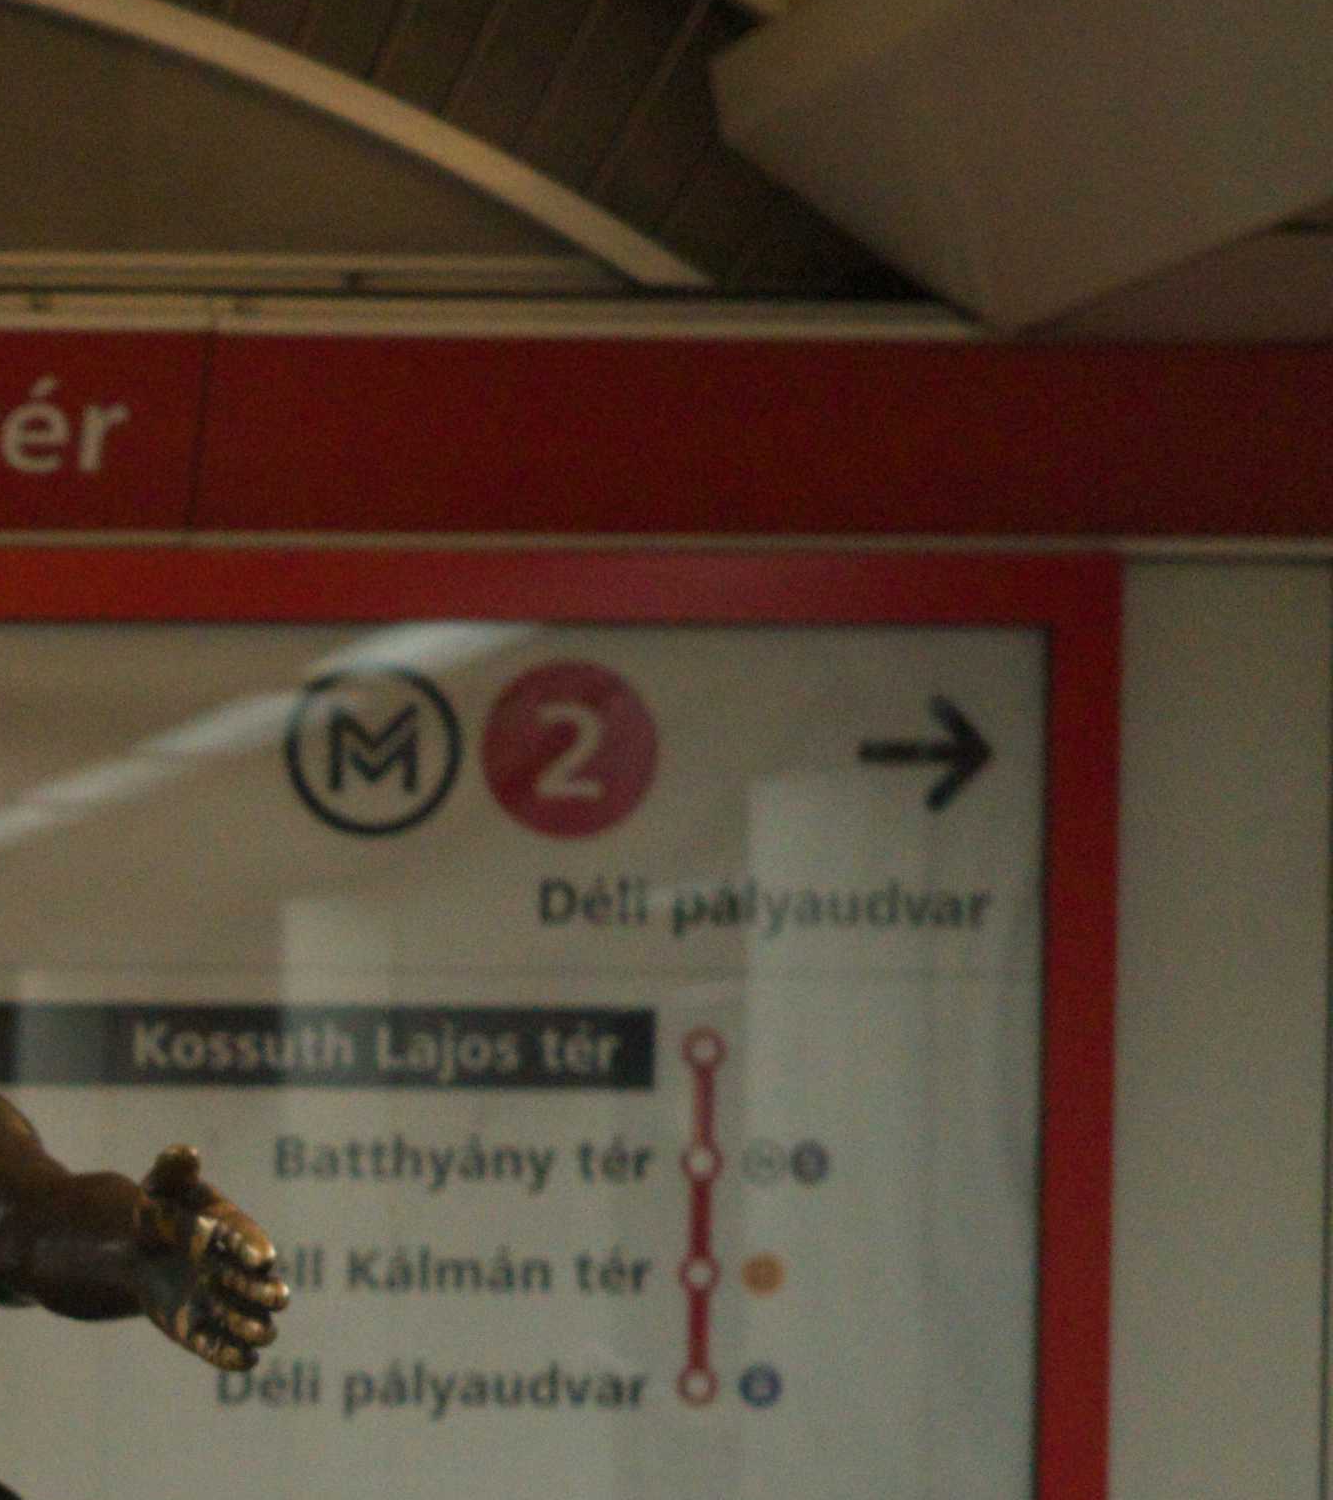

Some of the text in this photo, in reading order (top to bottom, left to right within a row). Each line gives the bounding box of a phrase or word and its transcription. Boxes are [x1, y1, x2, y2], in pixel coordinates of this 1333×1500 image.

[535, 702, 604, 800] 2
[539, 878, 990, 937] Déli pályaudvar
[135, 1021, 622, 1083] Kossuth Lajos tér
[274, 1135, 655, 1191] Batthyány tér
[346, 1245, 552, 1293] Kálmán
[575, 1247, 654, 1293] tér
[343, 1360, 647, 1420] pályaudvar
